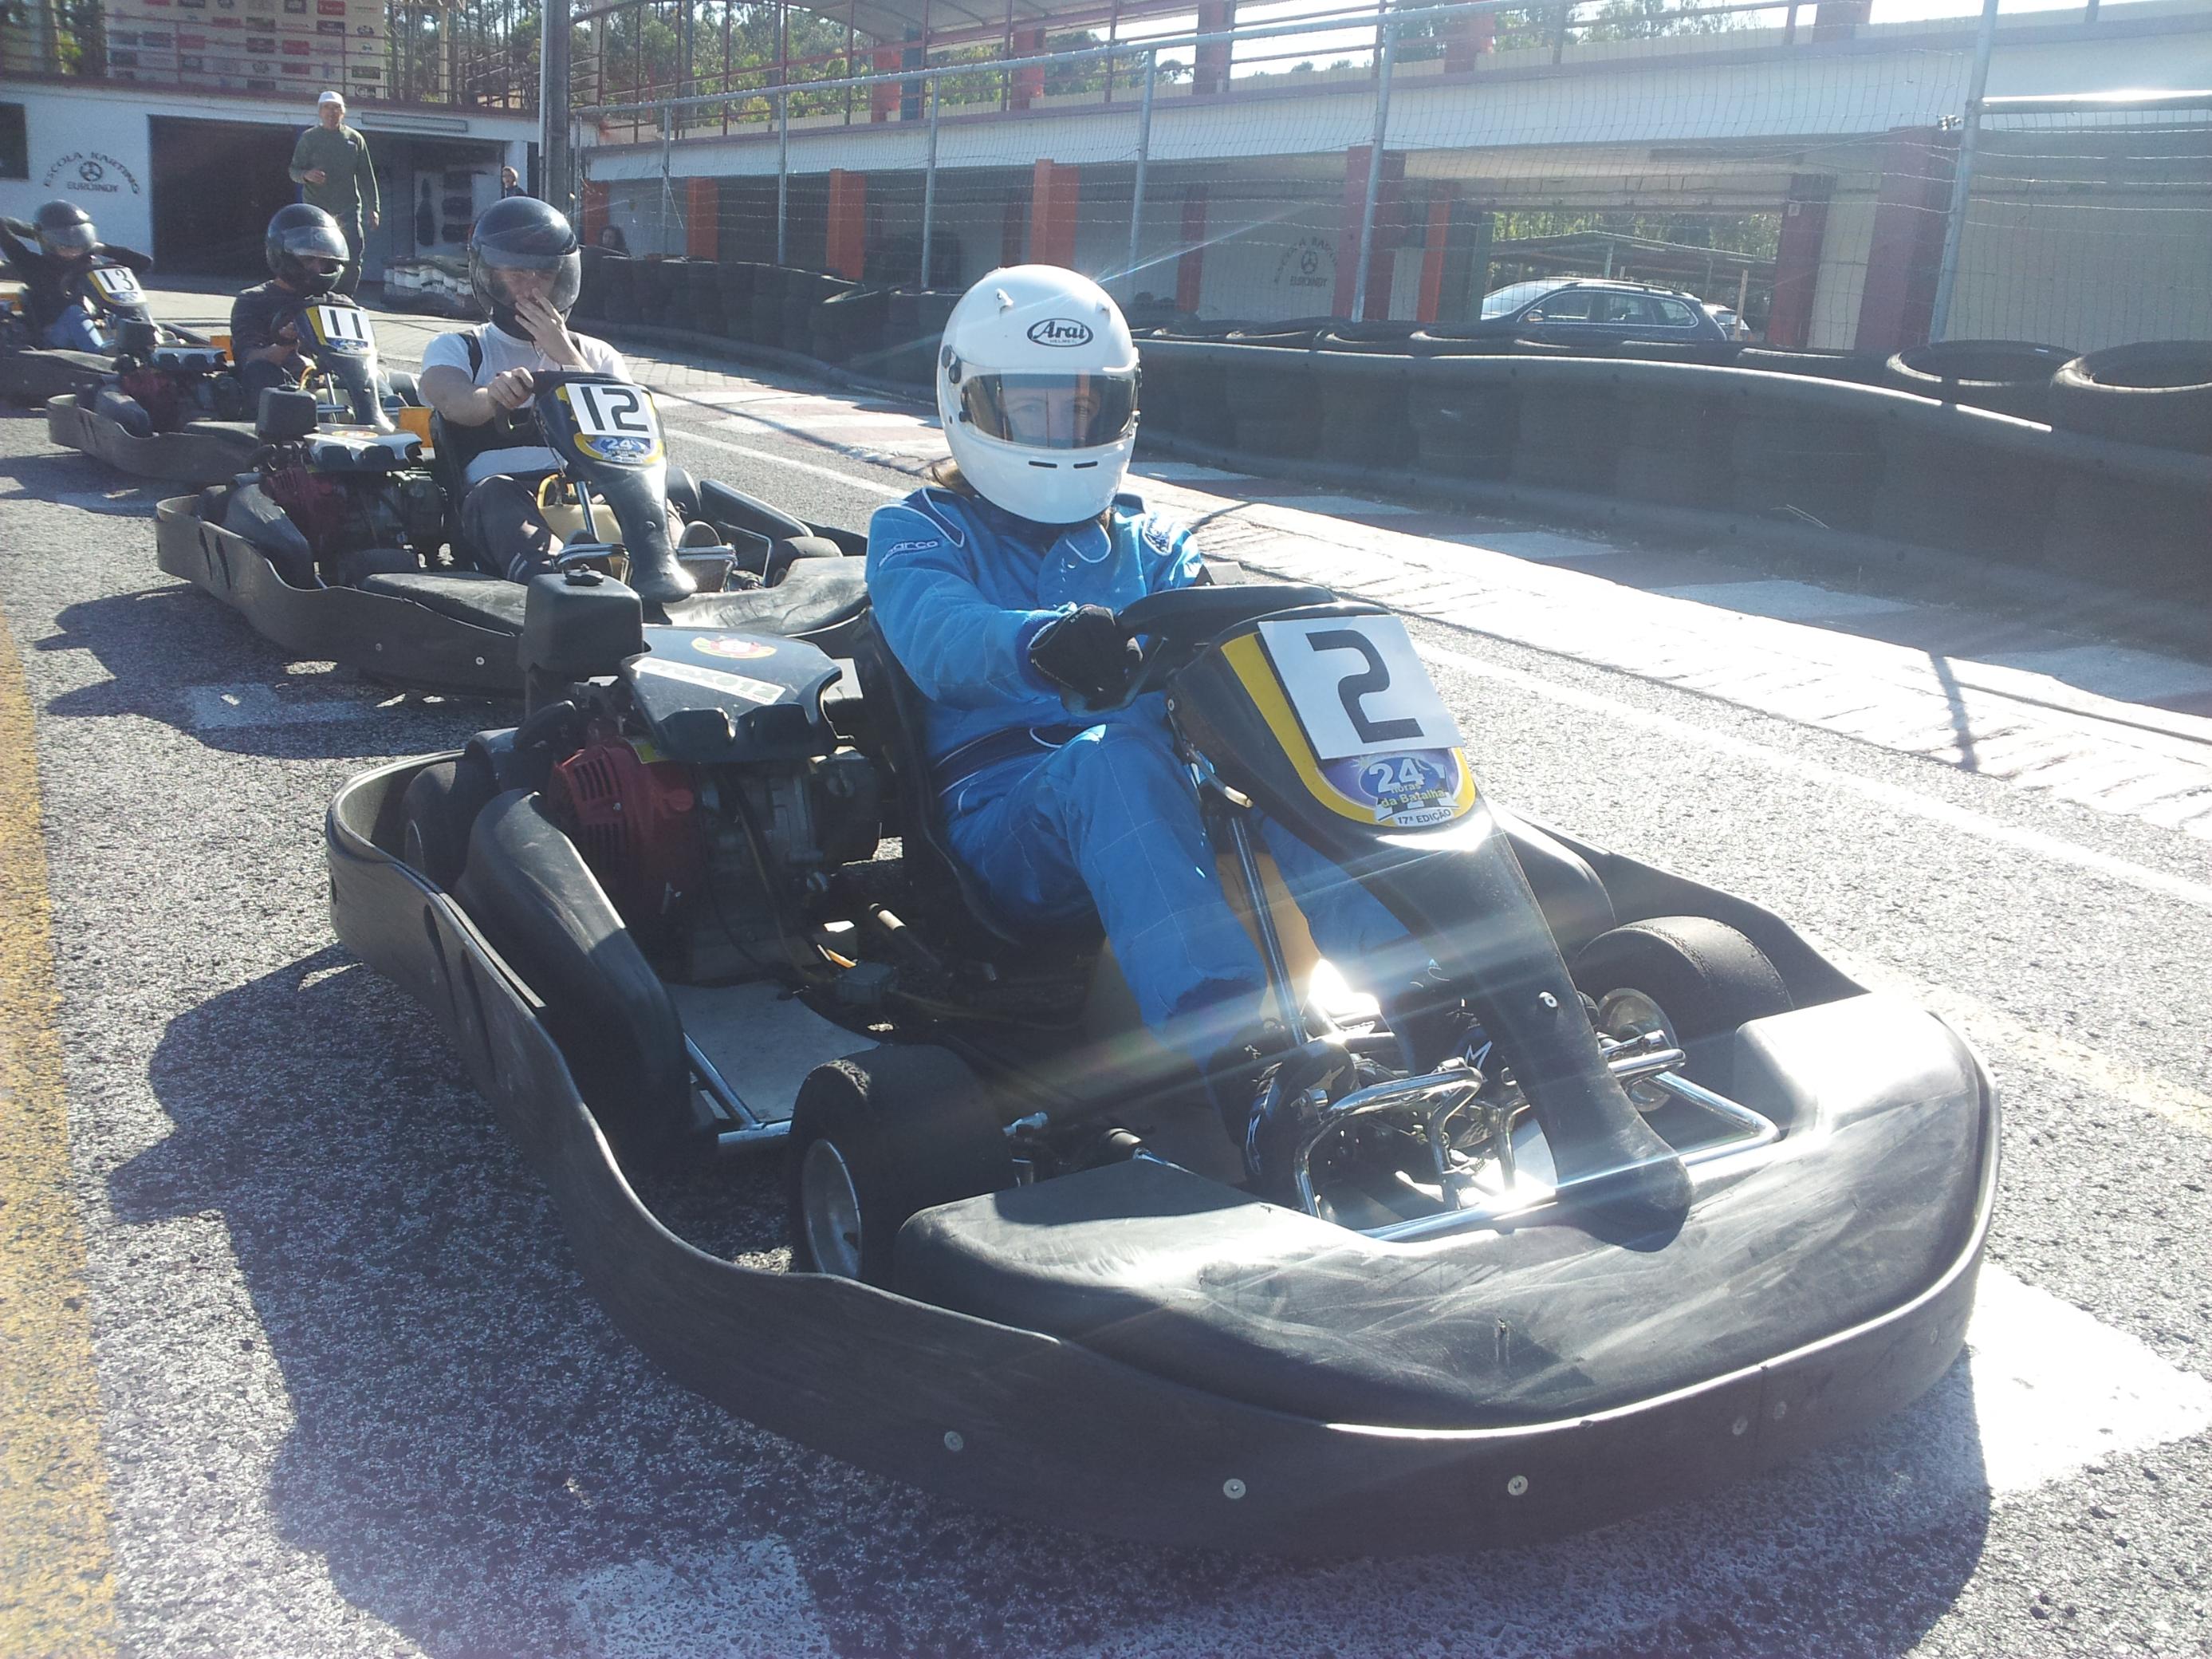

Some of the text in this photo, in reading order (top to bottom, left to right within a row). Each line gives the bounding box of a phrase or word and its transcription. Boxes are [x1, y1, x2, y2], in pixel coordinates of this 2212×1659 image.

[43, 152, 83, 187] ESCOLA
[66, 181, 119, 192] EUROINDY
[100, 269, 134, 291] 13
[329, 309, 364, 339] 11
[1033, 321, 1085, 339] Arai
[580, 386, 649, 431] 12
[1305, 629, 1424, 744] 2
[1368, 759, 1425, 794] 24
[1381, 788, 1446, 808] da Batalha
[1417, 808, 1451, 823] EDIÇÃO
